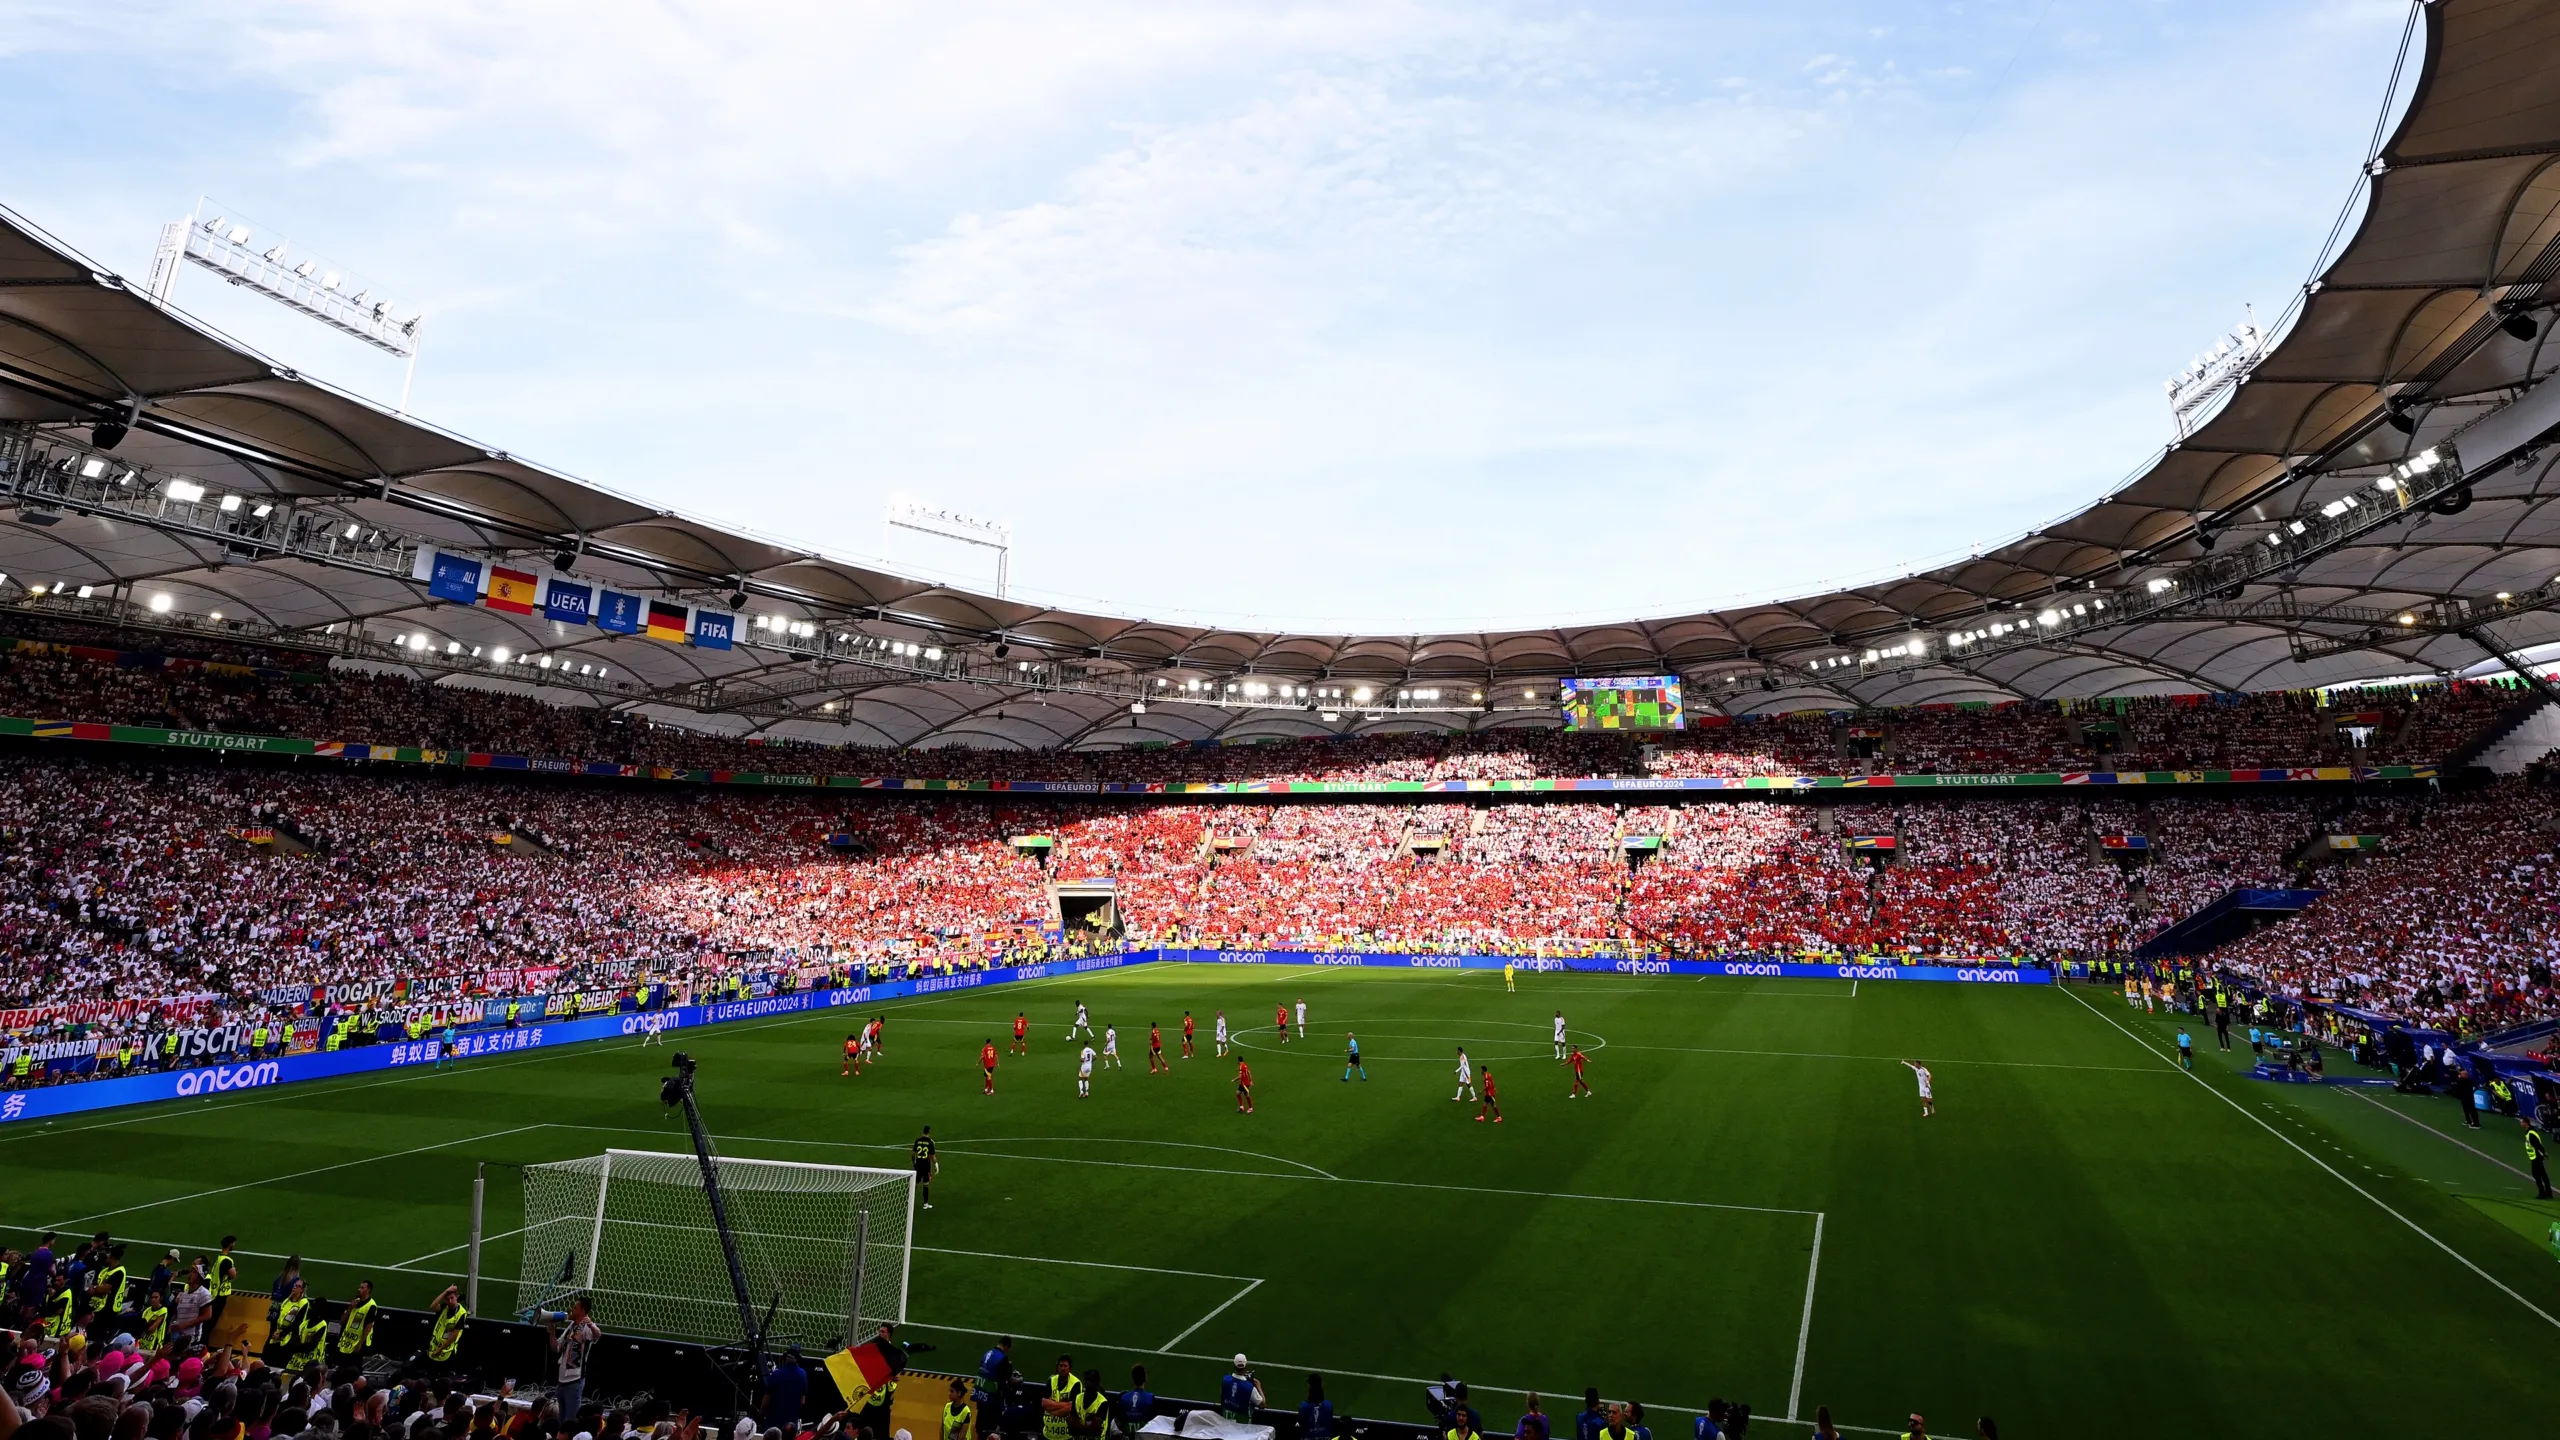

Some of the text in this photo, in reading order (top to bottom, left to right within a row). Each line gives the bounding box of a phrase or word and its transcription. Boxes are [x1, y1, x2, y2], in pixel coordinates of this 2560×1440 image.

[551, 593, 585, 612] UEFA
[700, 622, 728, 639] FIFA
[167, 732, 267, 749] STUTTGART
[1323, 783, 1387, 792] STUTTGART
[1936, 776, 2016, 784] STUTTGART
[1219, 952, 1265, 963] antom
[1313, 953, 1362, 965] antom
[1411, 955, 1461, 968] antom
[1018, 965, 1045, 980] antom
[1725, 963, 1781, 976] antom
[1838, 965, 1897, 979] antom
[1957, 969, 2019, 982] antom
[916, 973, 982, 992] 蚂蚁国际商业支付服务
[325, 980, 395, 1003] ROGATZ
[831, 987, 870, 1005] antom
[7, 1039, 98, 1064] HCKENHEIM
[143, 1026, 241, 1061] KTSCH
[391, 1028, 543, 1064] 蚂蚁国商业支付服务
[177, 1062, 279, 1096] antom
[916, 1146, 929, 1159] 23
